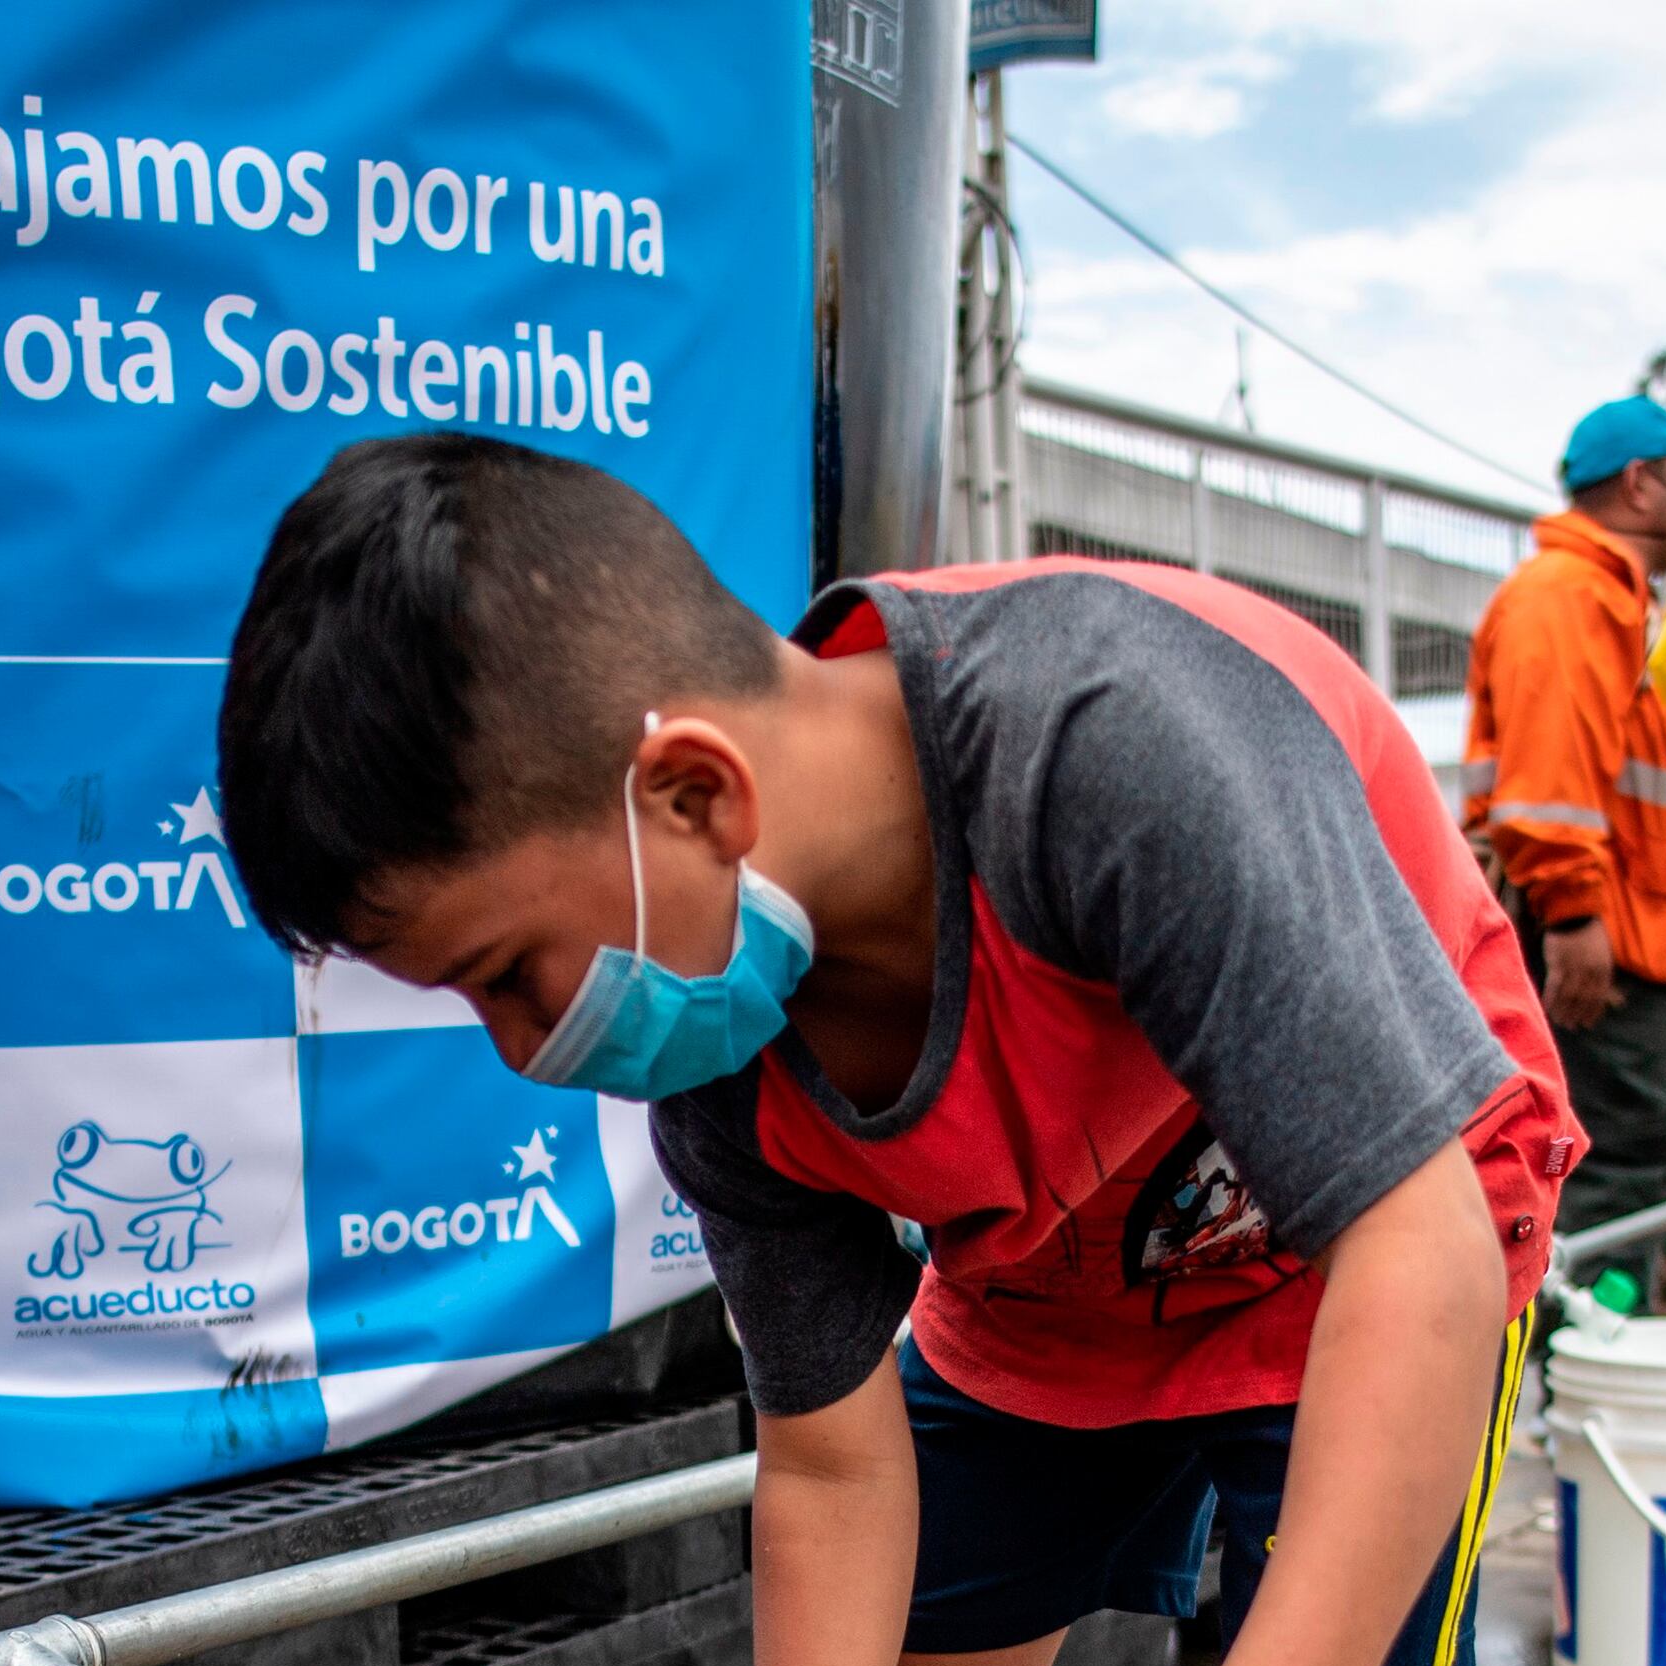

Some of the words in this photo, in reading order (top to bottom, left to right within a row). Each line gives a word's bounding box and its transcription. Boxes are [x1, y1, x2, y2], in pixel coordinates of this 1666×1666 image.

[356, 156, 509, 272] por
[528, 180, 666, 277] una
[205, 293, 652, 439] Sostenible
[14, 1278, 256, 1324] acueducto
